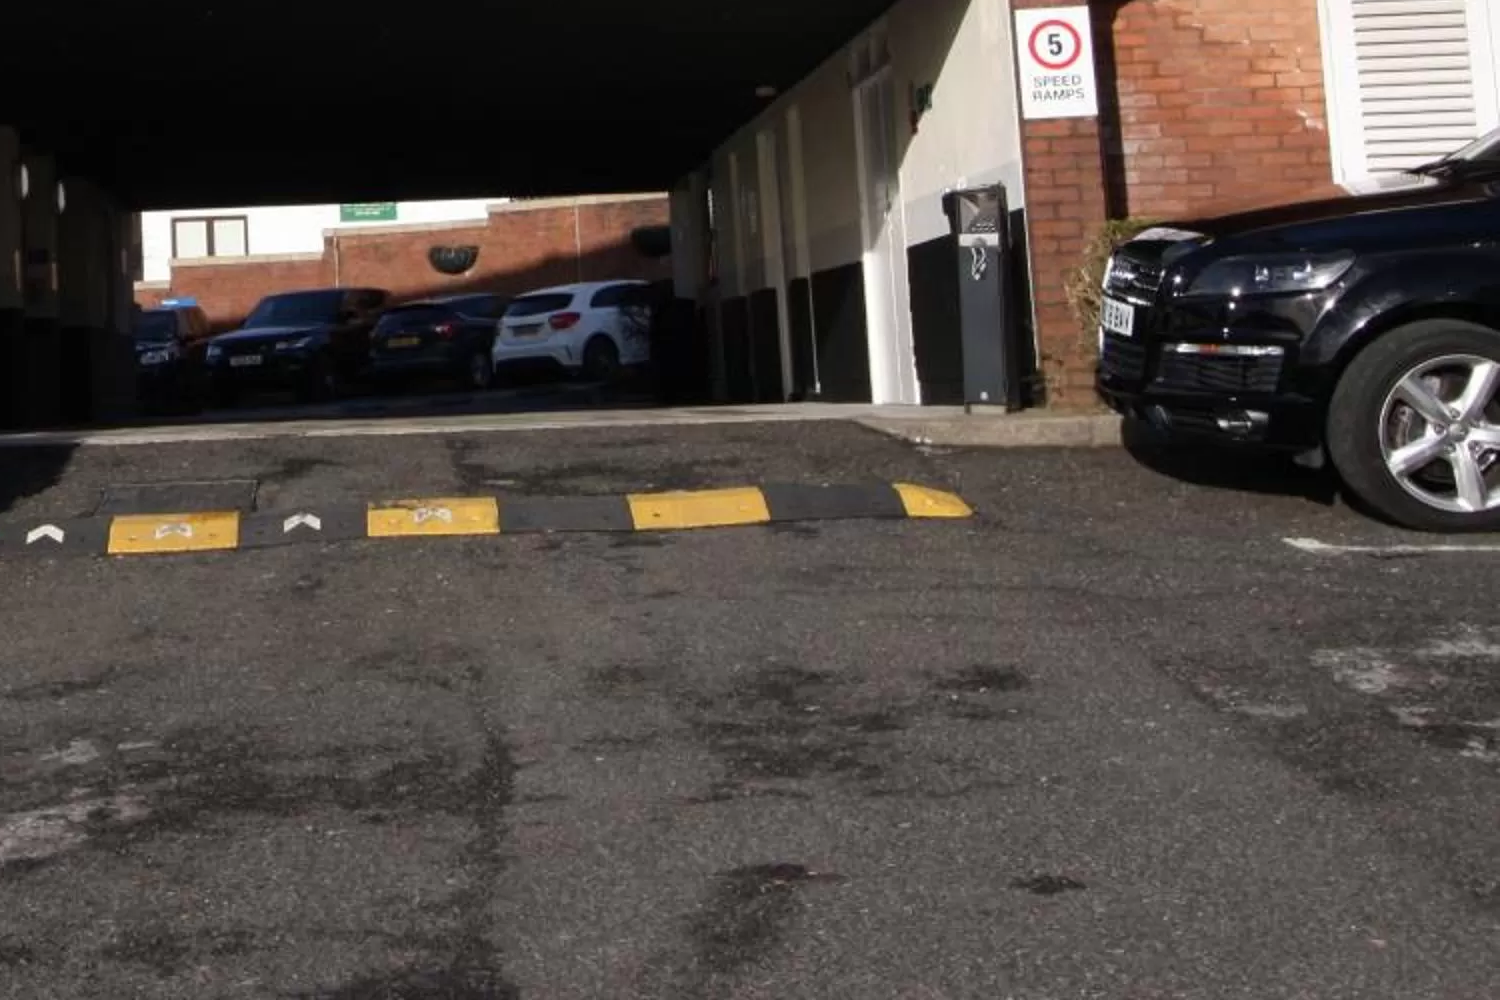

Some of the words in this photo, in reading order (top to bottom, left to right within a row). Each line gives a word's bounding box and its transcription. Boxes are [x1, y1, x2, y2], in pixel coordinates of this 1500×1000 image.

[1047, 33, 1063, 56] 5
[1033, 74, 1082, 88] SPEED
[1032, 87, 1085, 102] RAMPS
